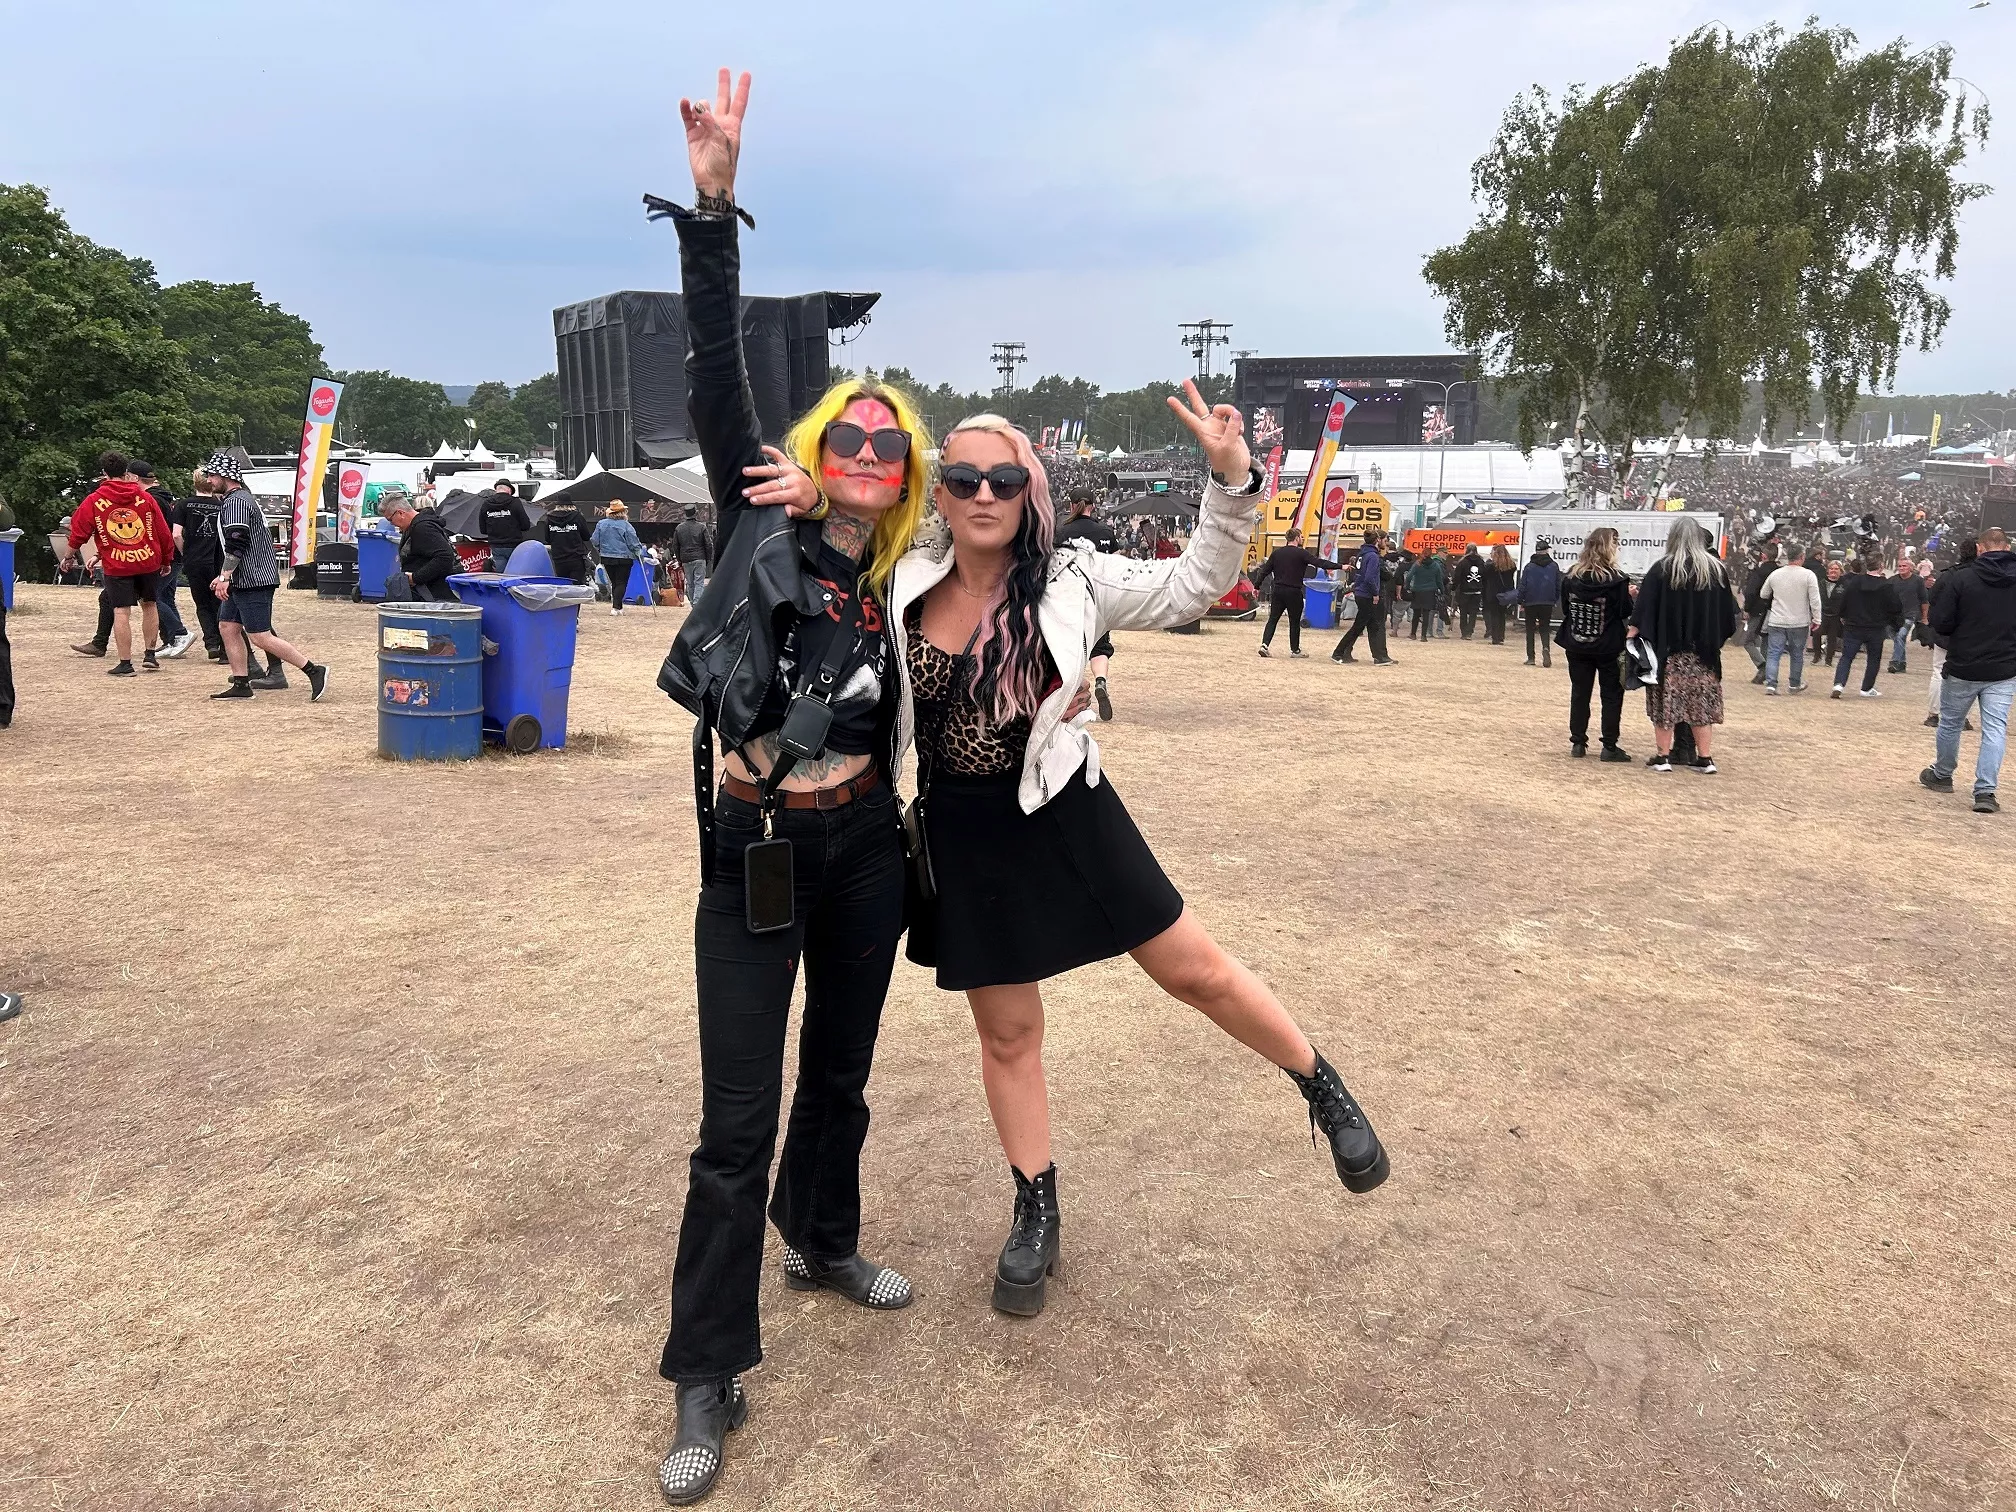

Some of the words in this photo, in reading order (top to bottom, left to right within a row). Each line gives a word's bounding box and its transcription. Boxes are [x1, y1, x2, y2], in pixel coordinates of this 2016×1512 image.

[1340, 523, 1382, 531] AGNEN
[1423, 533, 1466, 542] CHOPPED
[1536, 534, 1584, 546] Sölvesb
[110, 543, 155, 563] INSIDE
[1247, 535, 1259, 562] LAN
[1552, 550, 1578, 560] turn
